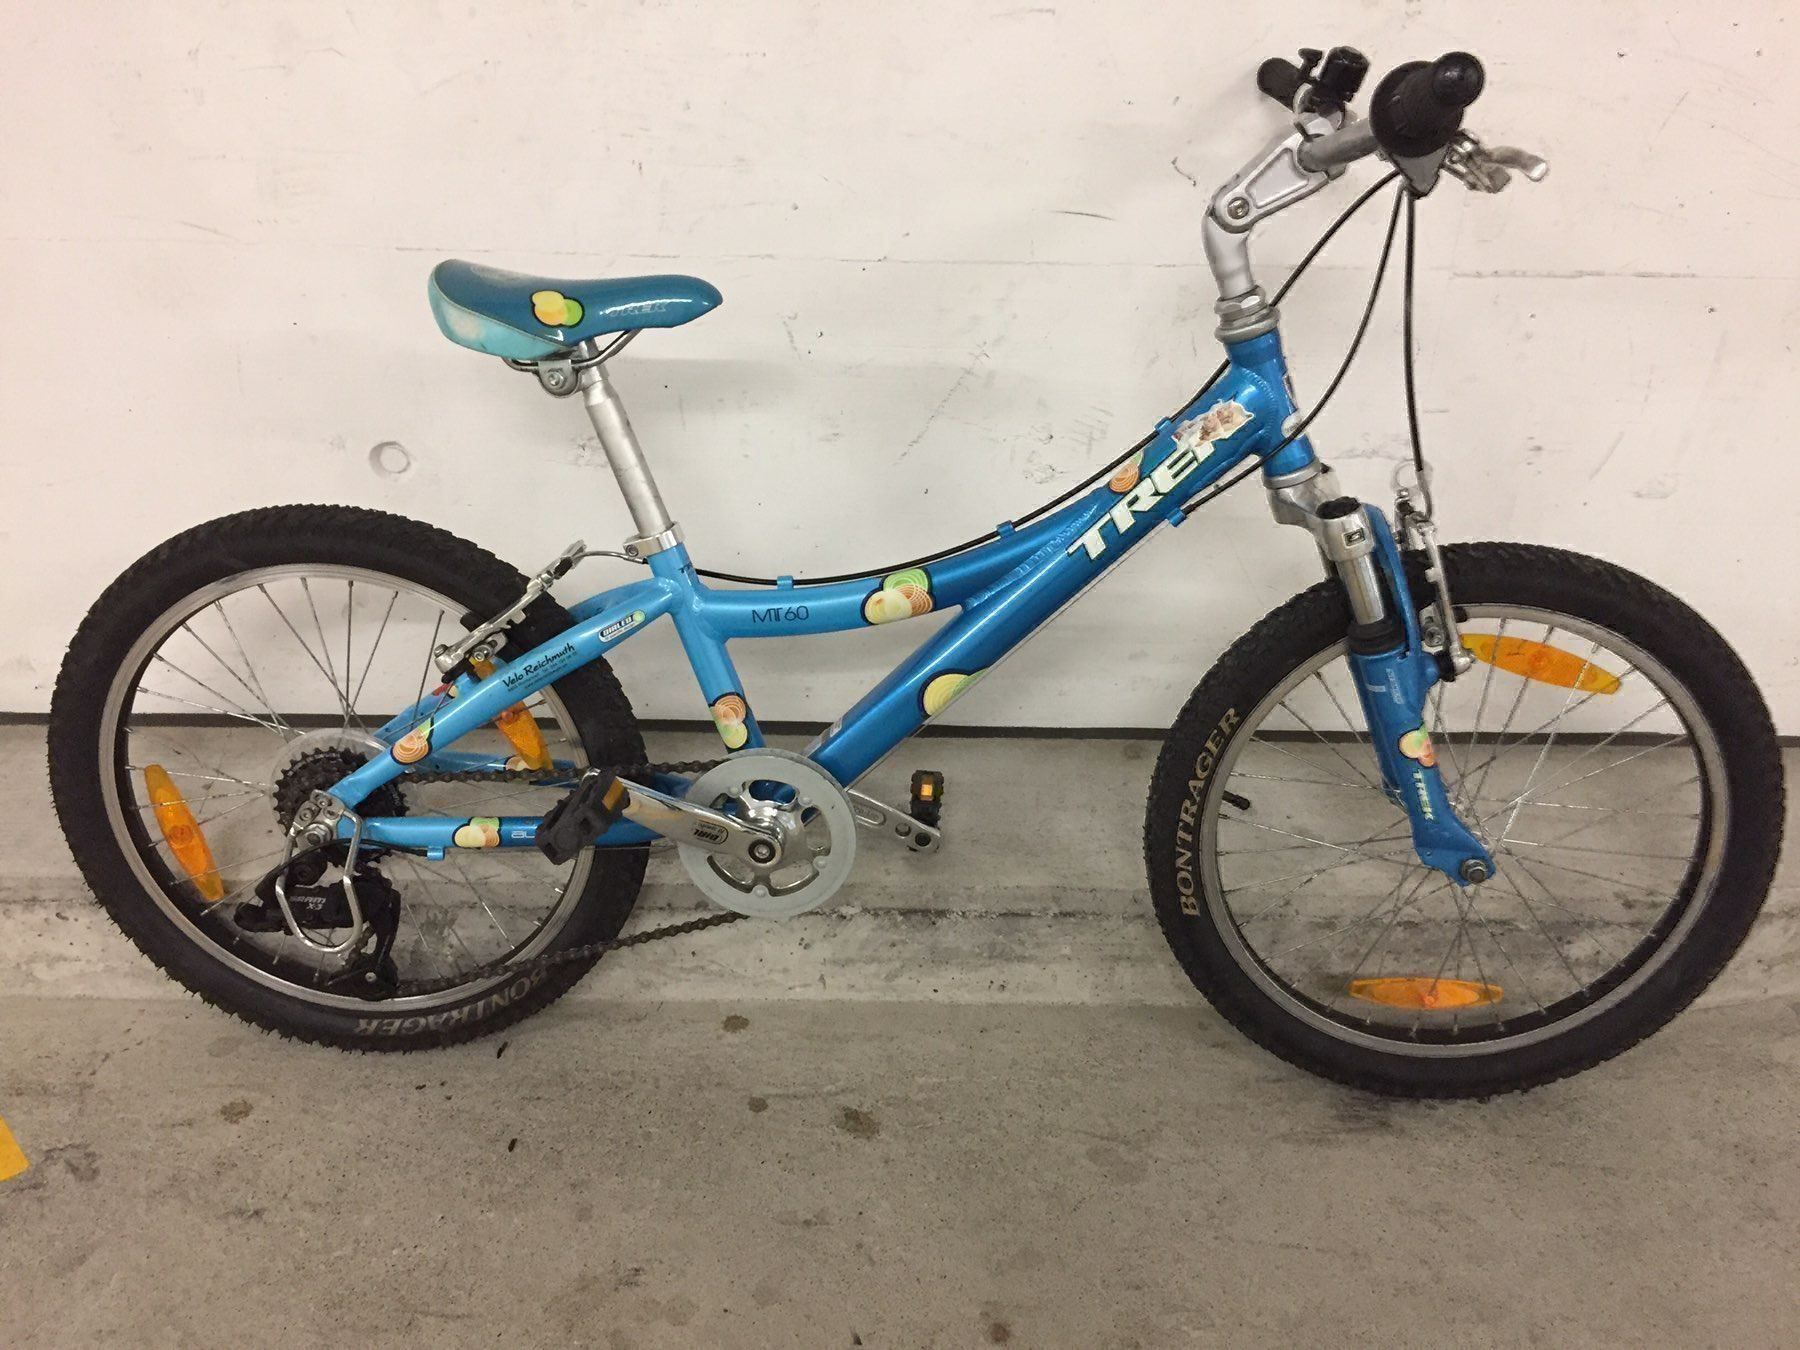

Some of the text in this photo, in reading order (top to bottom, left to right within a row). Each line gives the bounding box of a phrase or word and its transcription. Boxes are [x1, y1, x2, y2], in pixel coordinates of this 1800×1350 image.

[502, 672, 525, 688] Velo
[523, 642, 576, 676] Reichmuth
[1175, 707, 1241, 916] BONTRAGER
[1413, 768, 1435, 821] TREK
